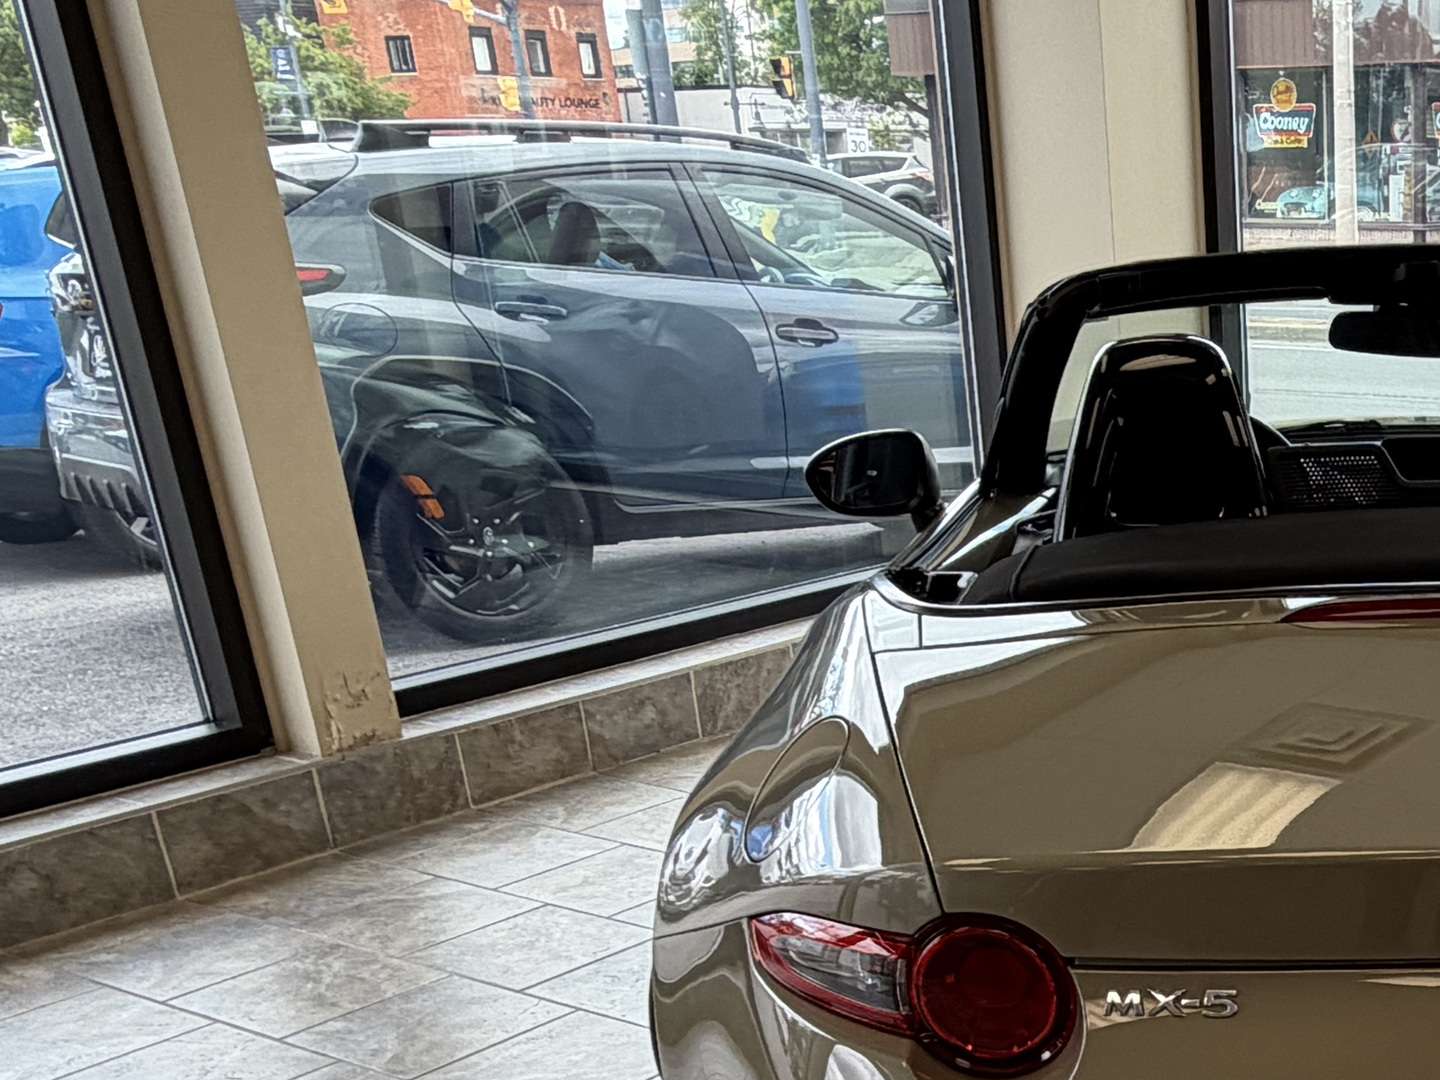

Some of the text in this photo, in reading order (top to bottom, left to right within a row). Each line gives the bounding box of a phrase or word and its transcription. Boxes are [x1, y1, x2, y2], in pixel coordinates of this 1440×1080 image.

[559, 97, 602, 109] LOUNGE
[1259, 111, 1310, 133] Cooney
[850, 139, 866, 153] 30
[1103, 988, 1240, 1019] MX-5
